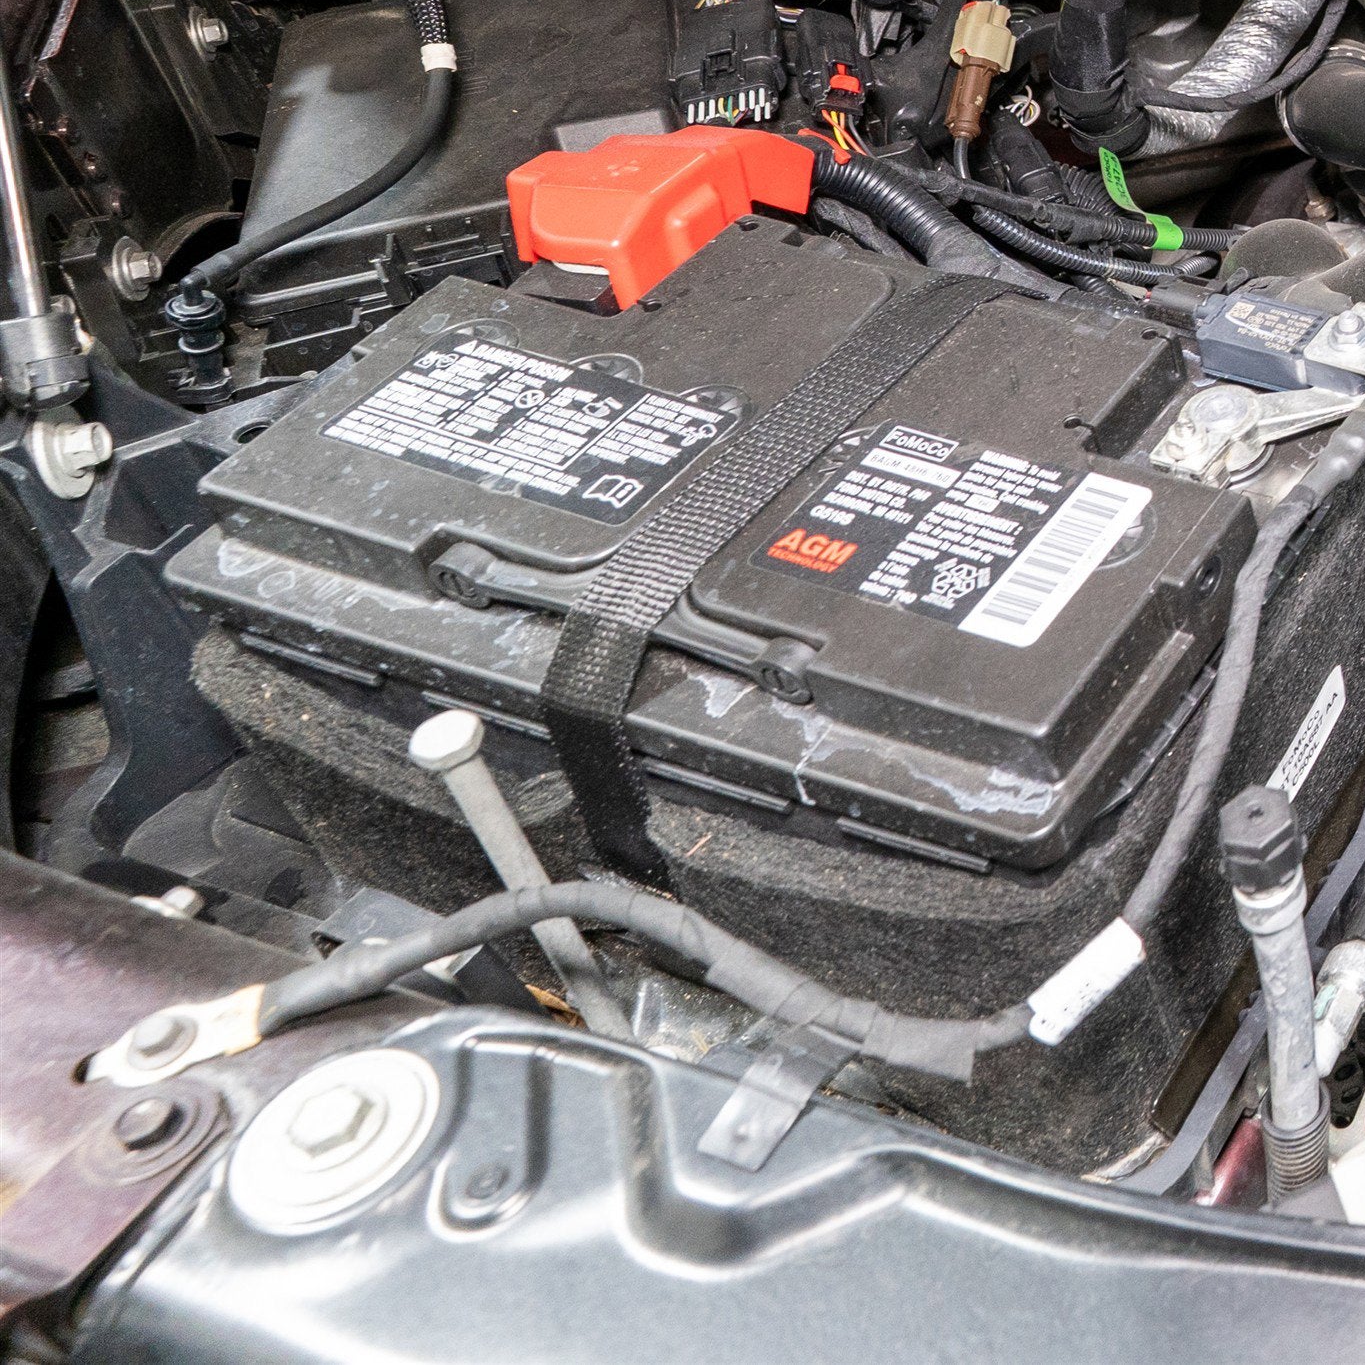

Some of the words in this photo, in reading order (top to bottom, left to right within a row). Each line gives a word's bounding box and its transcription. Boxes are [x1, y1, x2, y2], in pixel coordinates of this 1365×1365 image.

[886, 431, 952, 457] FoMoCo
[774, 525, 859, 566] AGM
[1326, 692, 1338, 714] AA
[1282, 710, 1320, 774] FoMoCo
